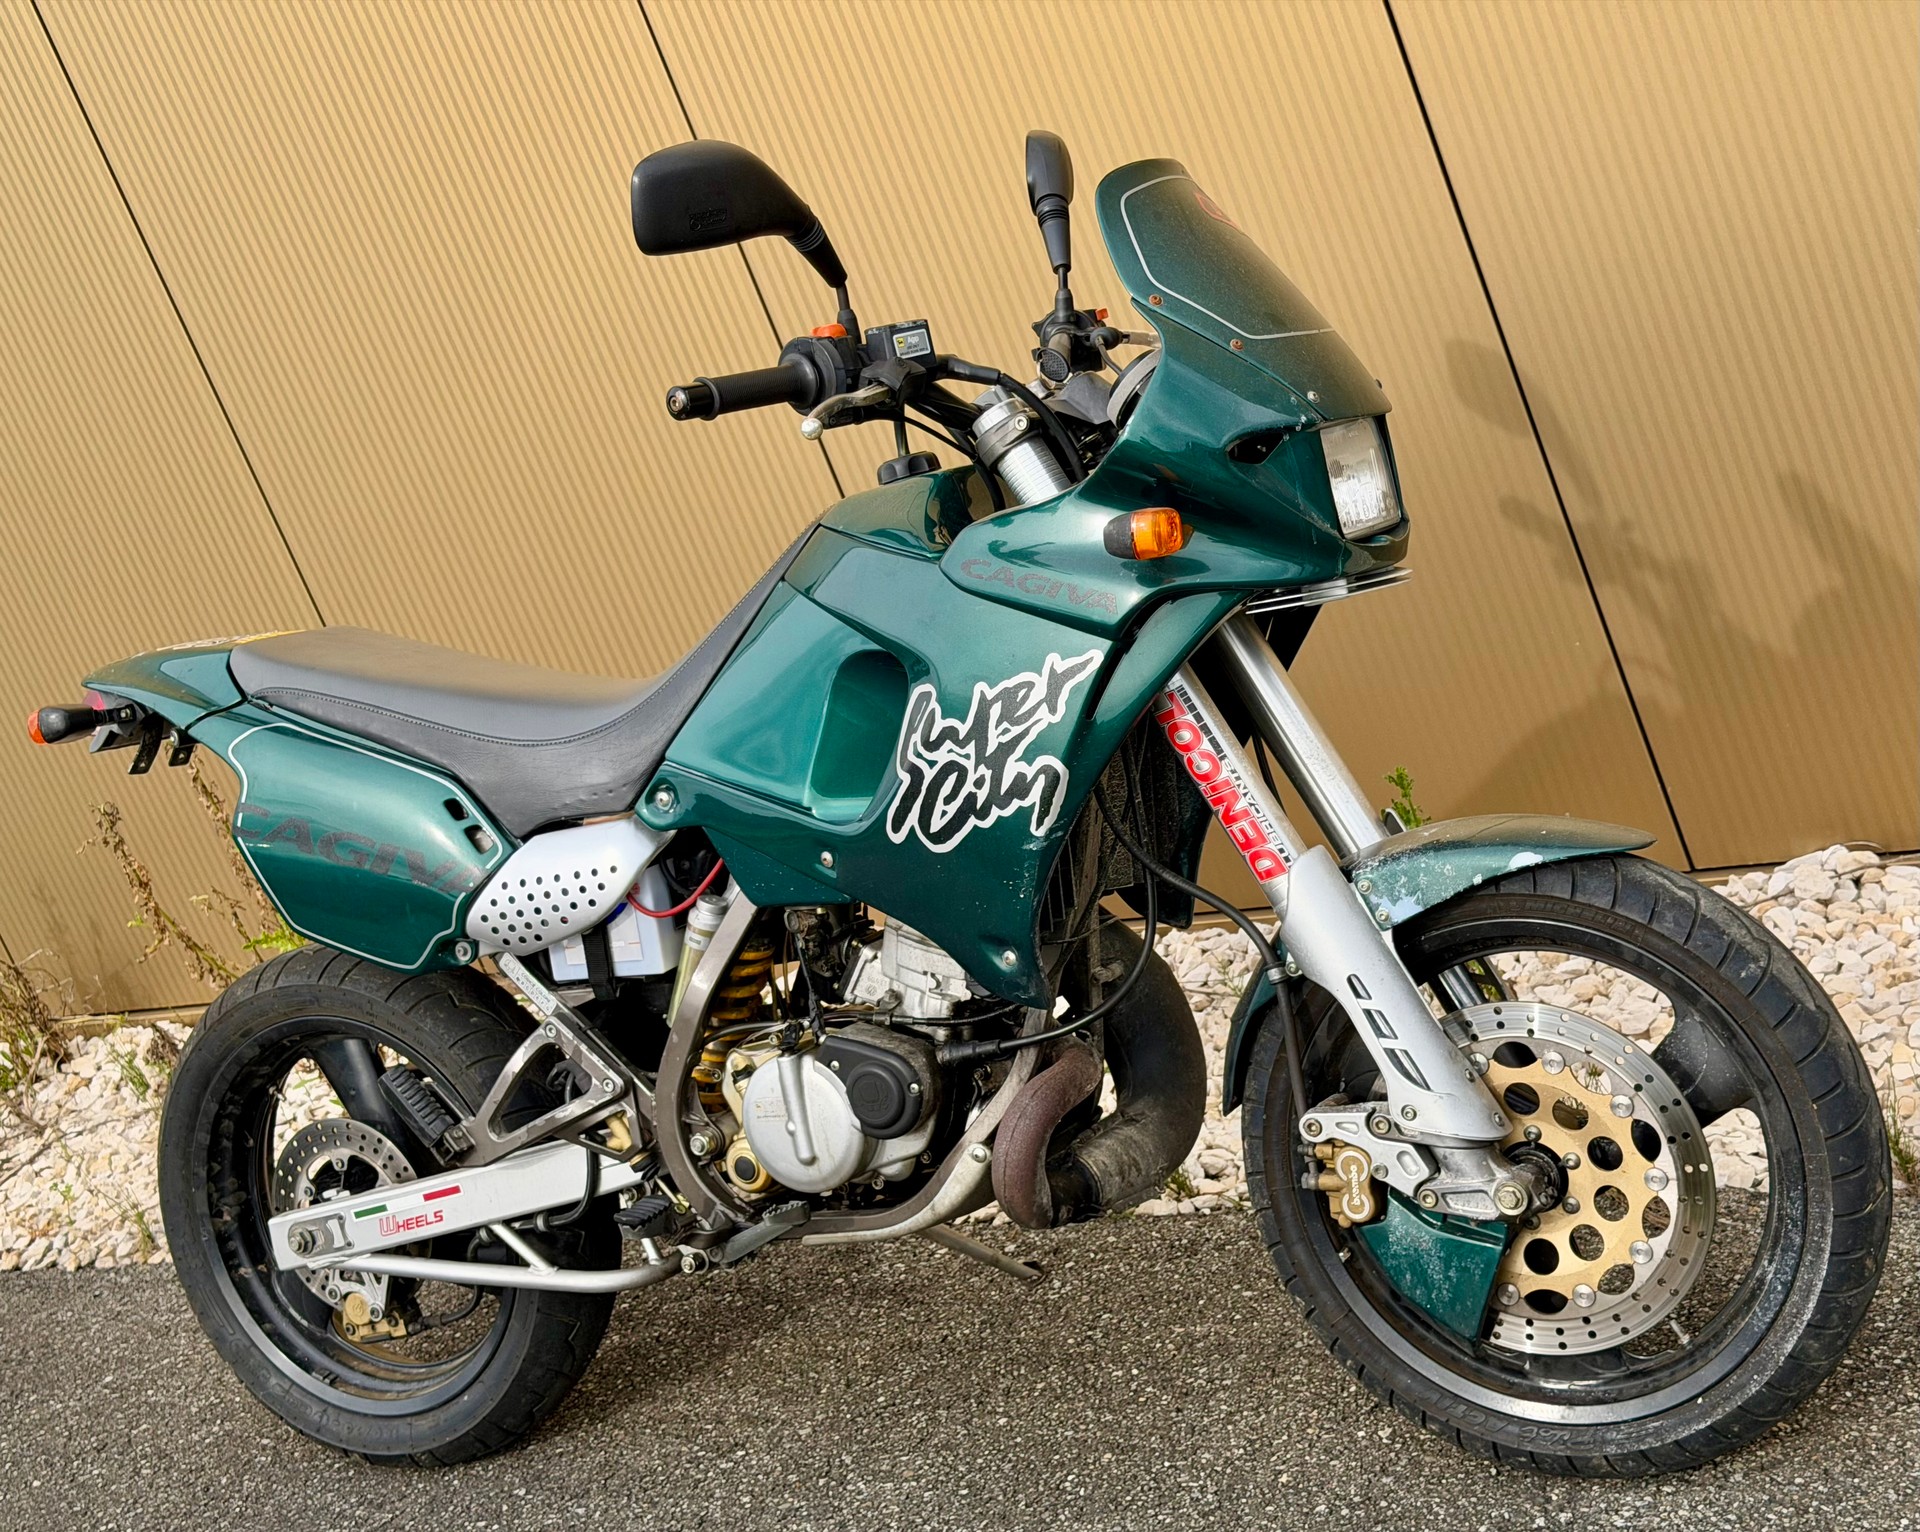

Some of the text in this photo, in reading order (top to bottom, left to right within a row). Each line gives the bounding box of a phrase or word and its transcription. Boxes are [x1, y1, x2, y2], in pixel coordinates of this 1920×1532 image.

[960, 558, 1119, 615] CAGIVA
[1223, 758, 1294, 868] LUBRICANTS
[233, 803, 487, 894] CAGIVA
[1349, 1165, 1360, 1205] brembo
[1520, 1426, 1595, 1450] Pilot
